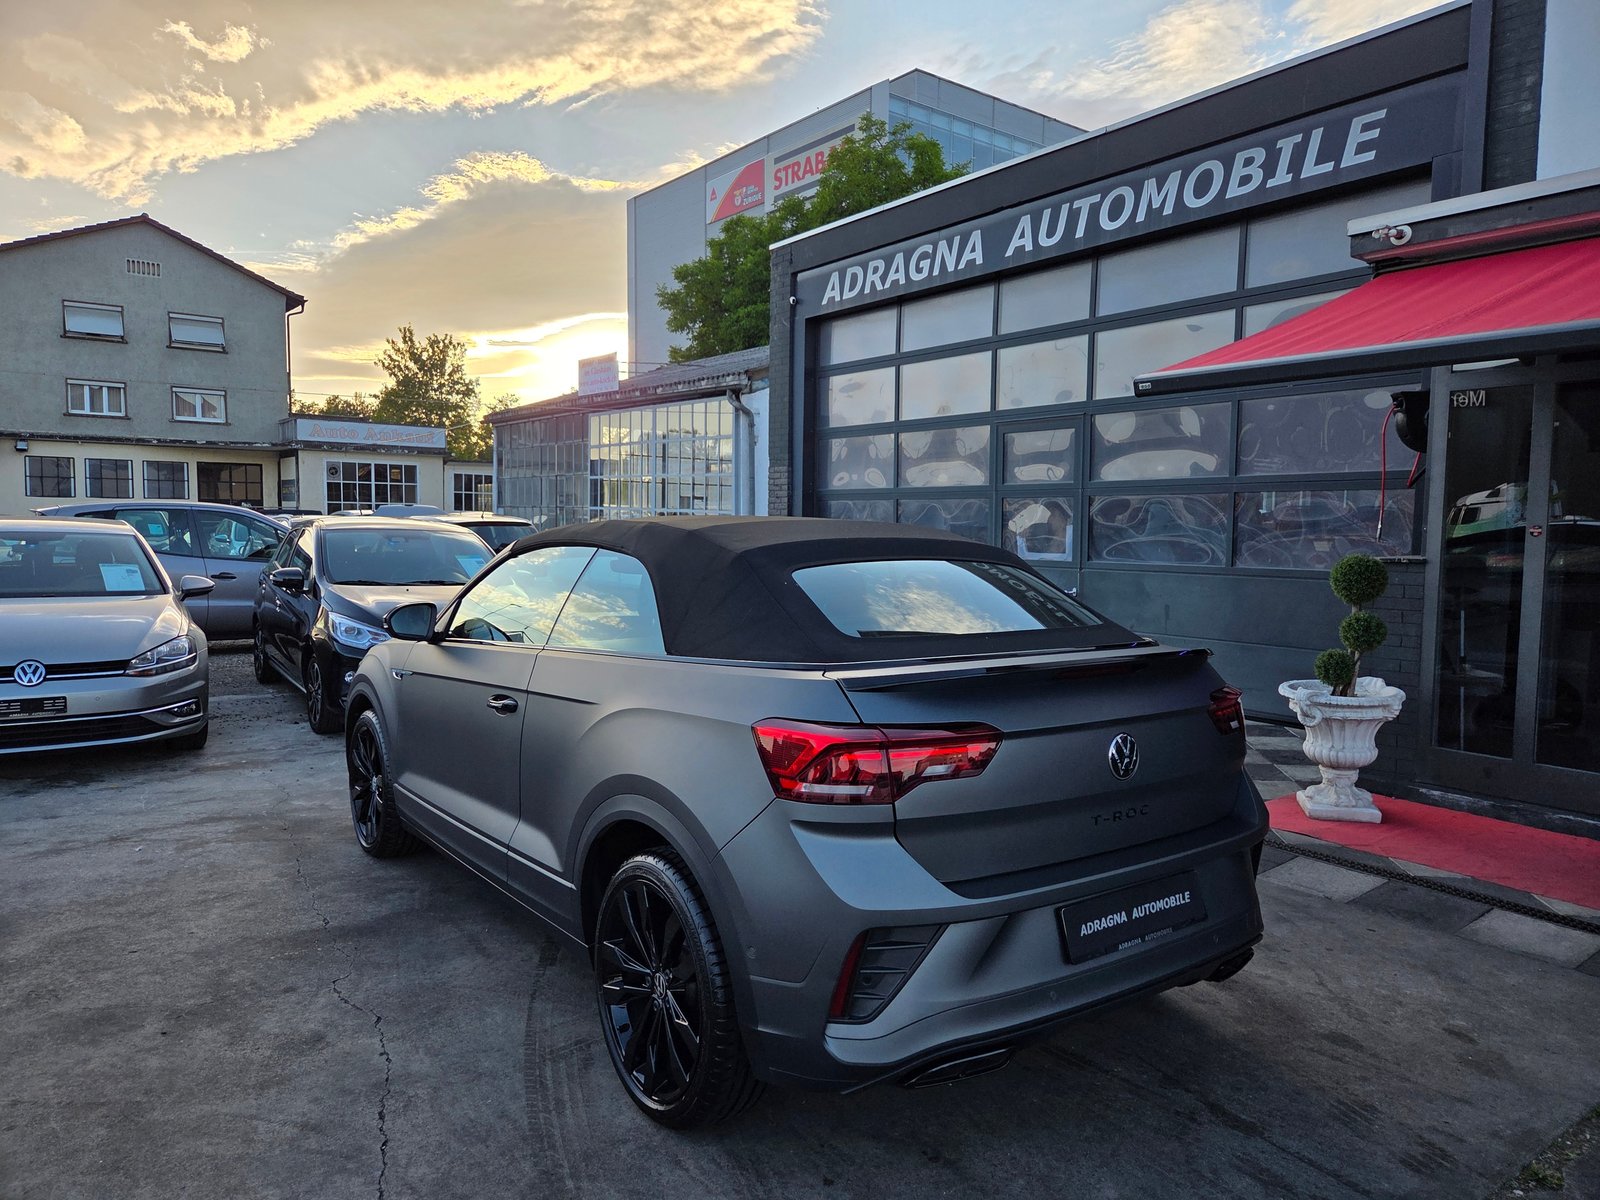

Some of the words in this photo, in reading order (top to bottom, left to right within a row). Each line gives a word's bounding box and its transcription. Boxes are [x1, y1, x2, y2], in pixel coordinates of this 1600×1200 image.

[821, 229, 984, 306] ADRAGNA
[1004, 107, 1388, 258] AUTOMOBILE
[309, 423, 359, 441] Auto
[1091, 804, 1150, 826] T-ROC
[1080, 911, 1128, 937] ADRAGNA
[1132, 891, 1191, 920] AUTOMOBILE
[1118, 938, 1142, 951] ADRAGNA
